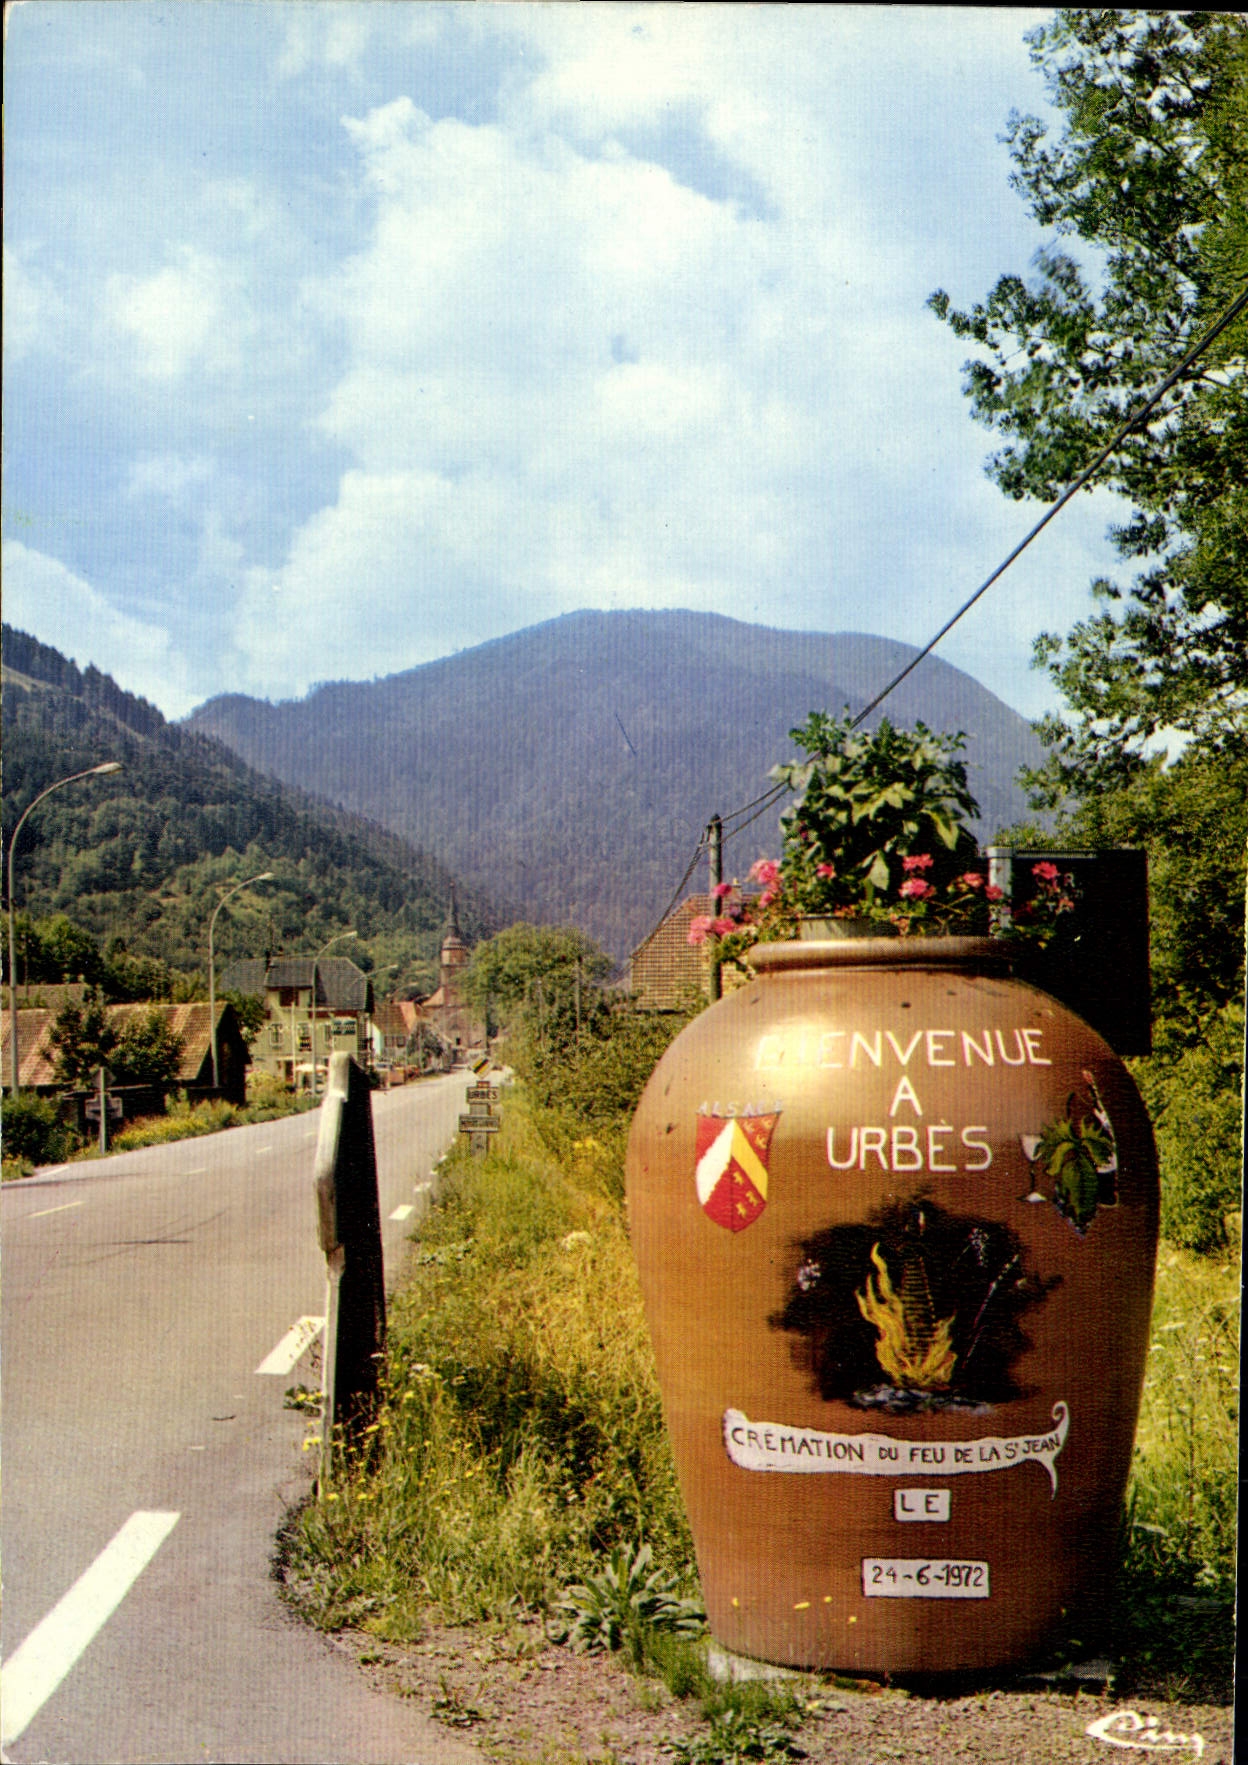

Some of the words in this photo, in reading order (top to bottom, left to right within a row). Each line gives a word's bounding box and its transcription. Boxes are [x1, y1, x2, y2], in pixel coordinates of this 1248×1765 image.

[698, 1100, 783, 1118] ALSACE
[889, 1075, 924, 1118] A
[826, 1119, 993, 1173] URBÈS
[731, 1427, 865, 1461] CRÉMATION
[878, 1447, 899, 1461] DU
[909, 1447, 946, 1463] FEU
[954, 1448, 974, 1464] DE
[979, 1446, 1001, 1463] LA
[1022, 1433, 1061, 1454] JEAN
[900, 1494, 940, 1514] LE
